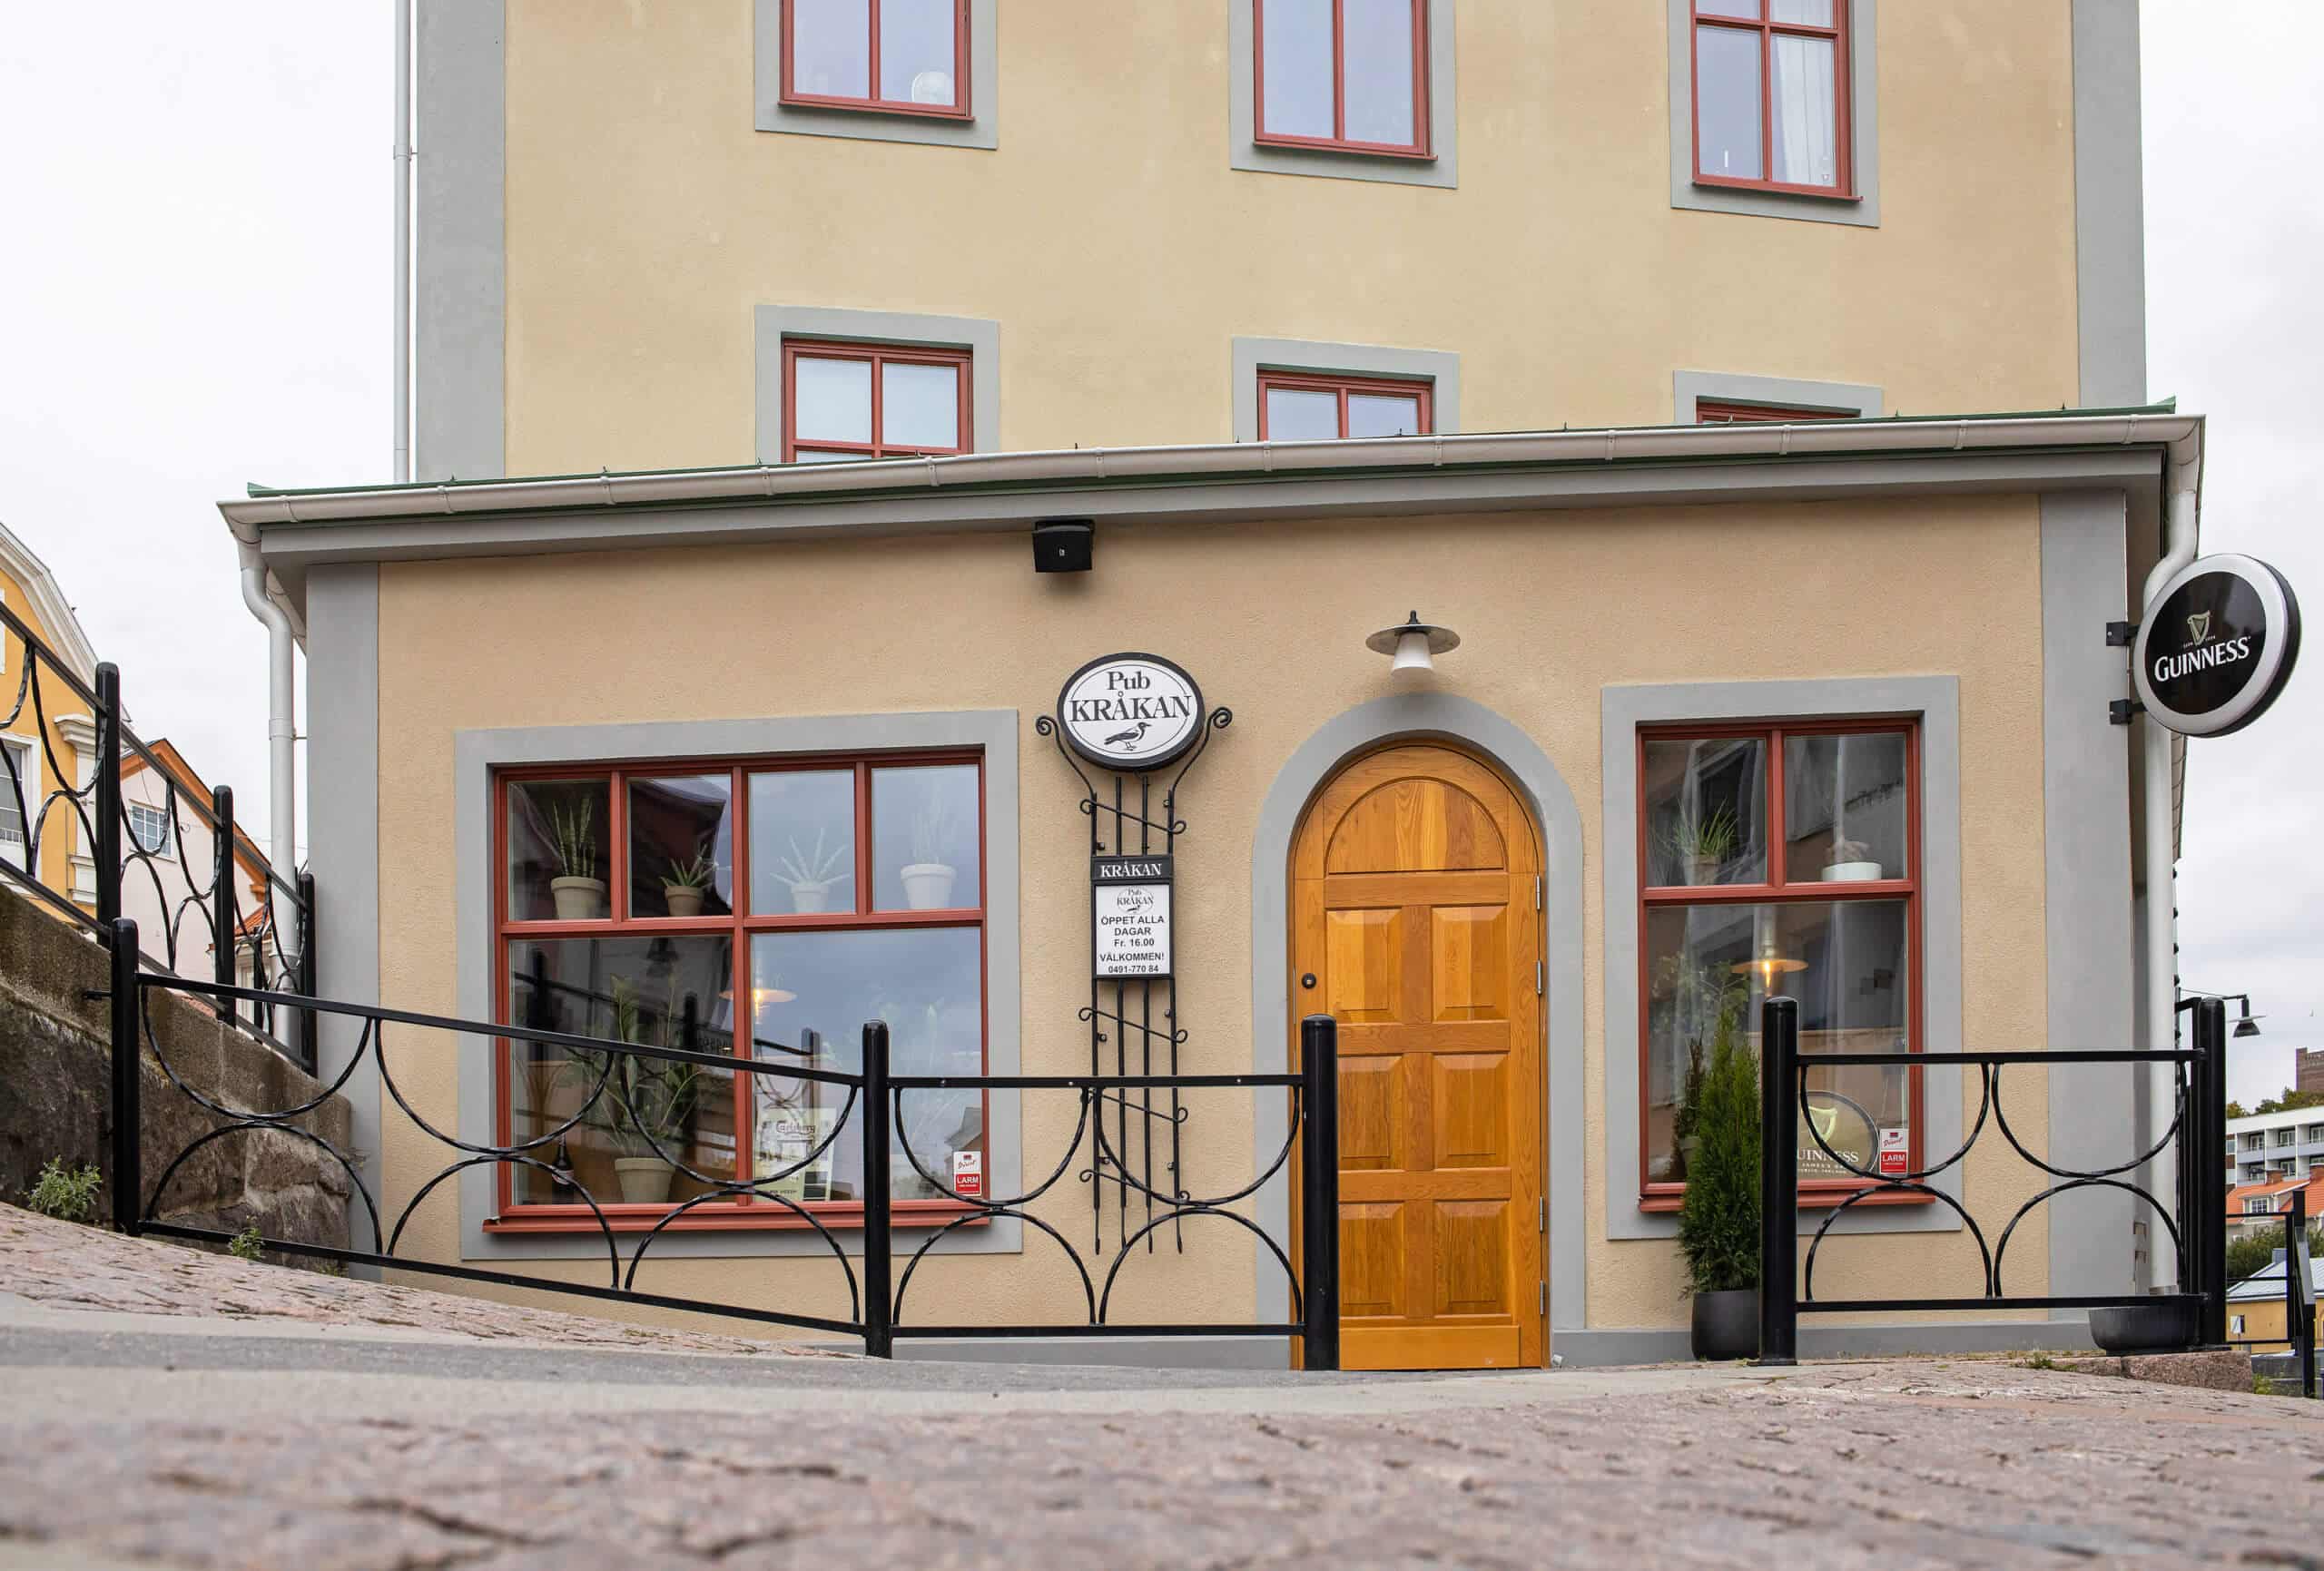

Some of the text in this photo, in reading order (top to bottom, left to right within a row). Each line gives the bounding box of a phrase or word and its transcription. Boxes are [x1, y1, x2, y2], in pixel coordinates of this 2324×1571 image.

[2154, 636, 2250, 682] GUINNESS
[1106, 670, 1151, 691] Pub
[1069, 691, 1192, 722] KRÅKAN
[1100, 860, 1162, 878] KRÅKAN
[1117, 894, 1154, 906] KRÅKAN
[1100, 915, 1165, 926] ÖPPET ALLA
[1114, 927, 1151, 936] DAGAR
[1114, 938, 1155, 947] Fr. 16.00
[1108, 965, 1159, 974] 0491-770 84
[1882, 1154, 1905, 1162] LARM
[957, 1175, 979, 1184] LARM
